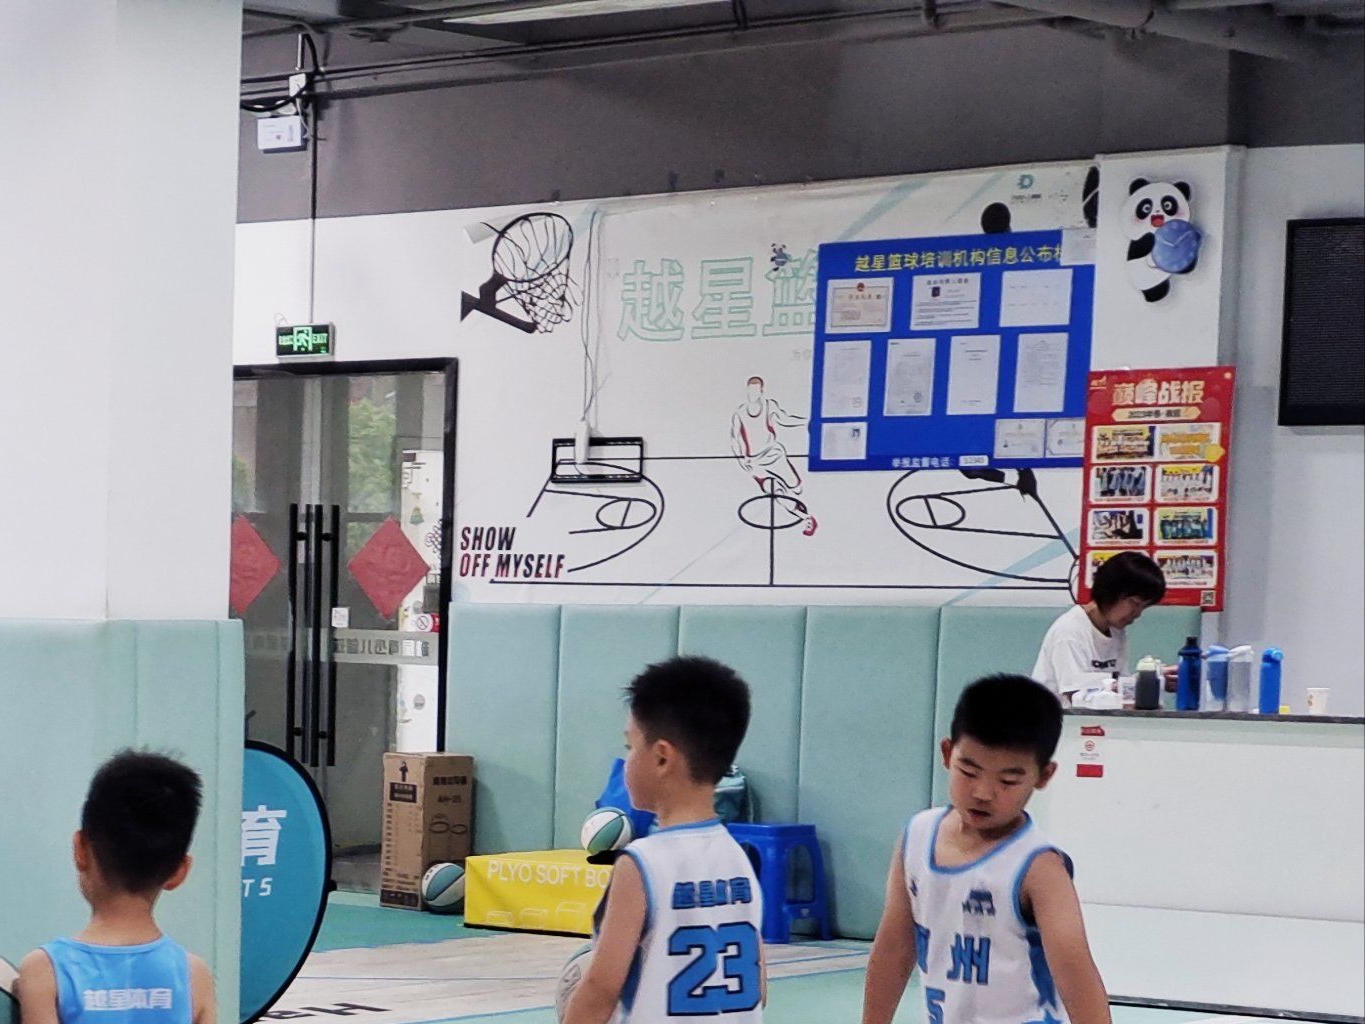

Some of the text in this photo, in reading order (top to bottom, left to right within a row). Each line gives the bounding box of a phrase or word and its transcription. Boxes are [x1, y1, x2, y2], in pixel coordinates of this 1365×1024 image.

[460, 526, 516, 551] SHOW
[459, 553, 565, 578] OFF MYSELF
[241, 804, 287, 867] 育
[487, 859, 532, 882] PLYO
[535, 863, 581, 885] SOFT
[667, 921, 762, 1016] 23
